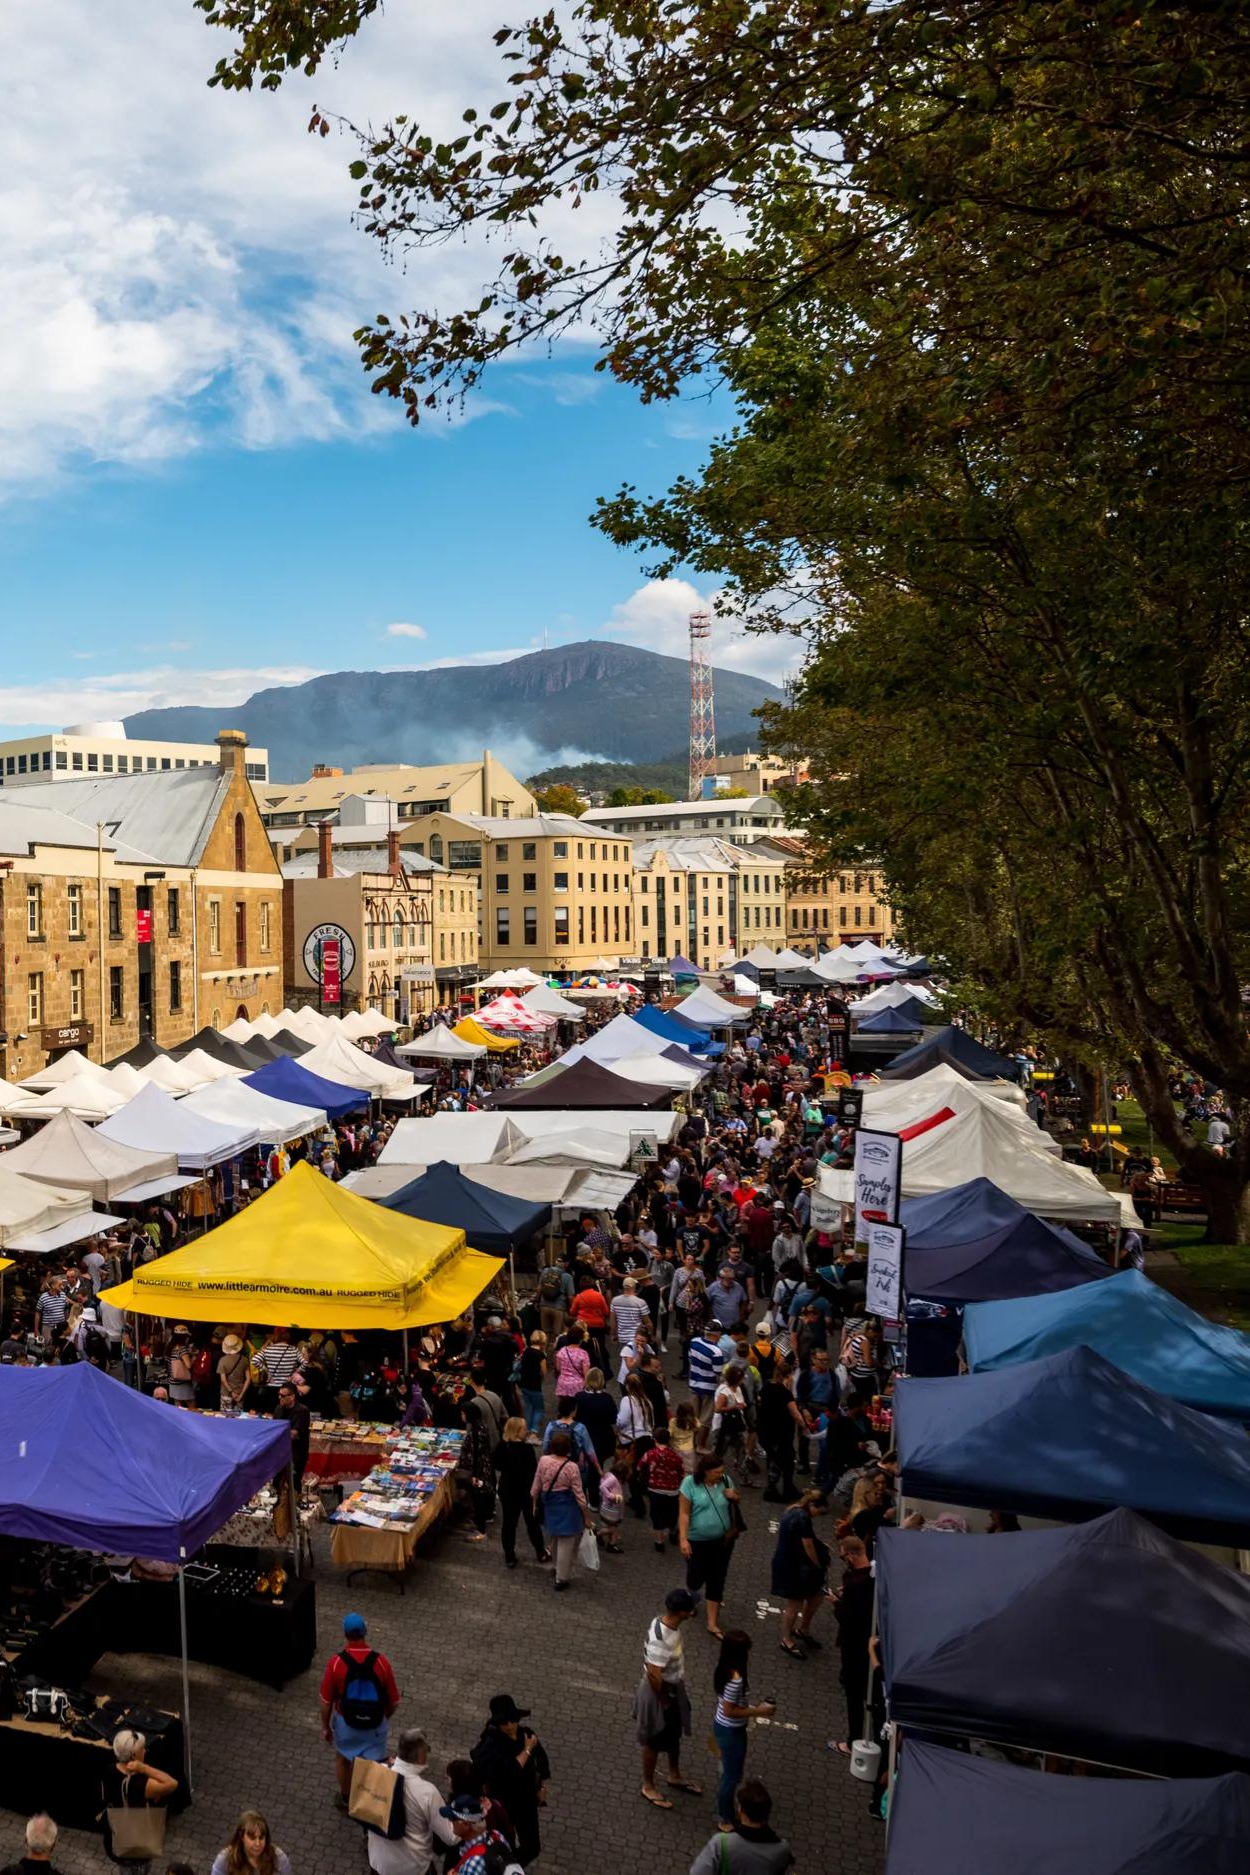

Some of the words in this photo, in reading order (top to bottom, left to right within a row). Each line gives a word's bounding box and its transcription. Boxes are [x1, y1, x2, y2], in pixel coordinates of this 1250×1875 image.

[313, 927, 346, 941] FRESH
[58, 1028, 80, 1039] cargo
[861, 1187, 888, 1206] Here
[137, 1279, 172, 1287] RUGGED
[197, 1280, 333, 1297] www.littlearmoire.com.au
[337, 1288, 376, 1297] RUGGED
[377, 1290, 401, 1299] HIDE
